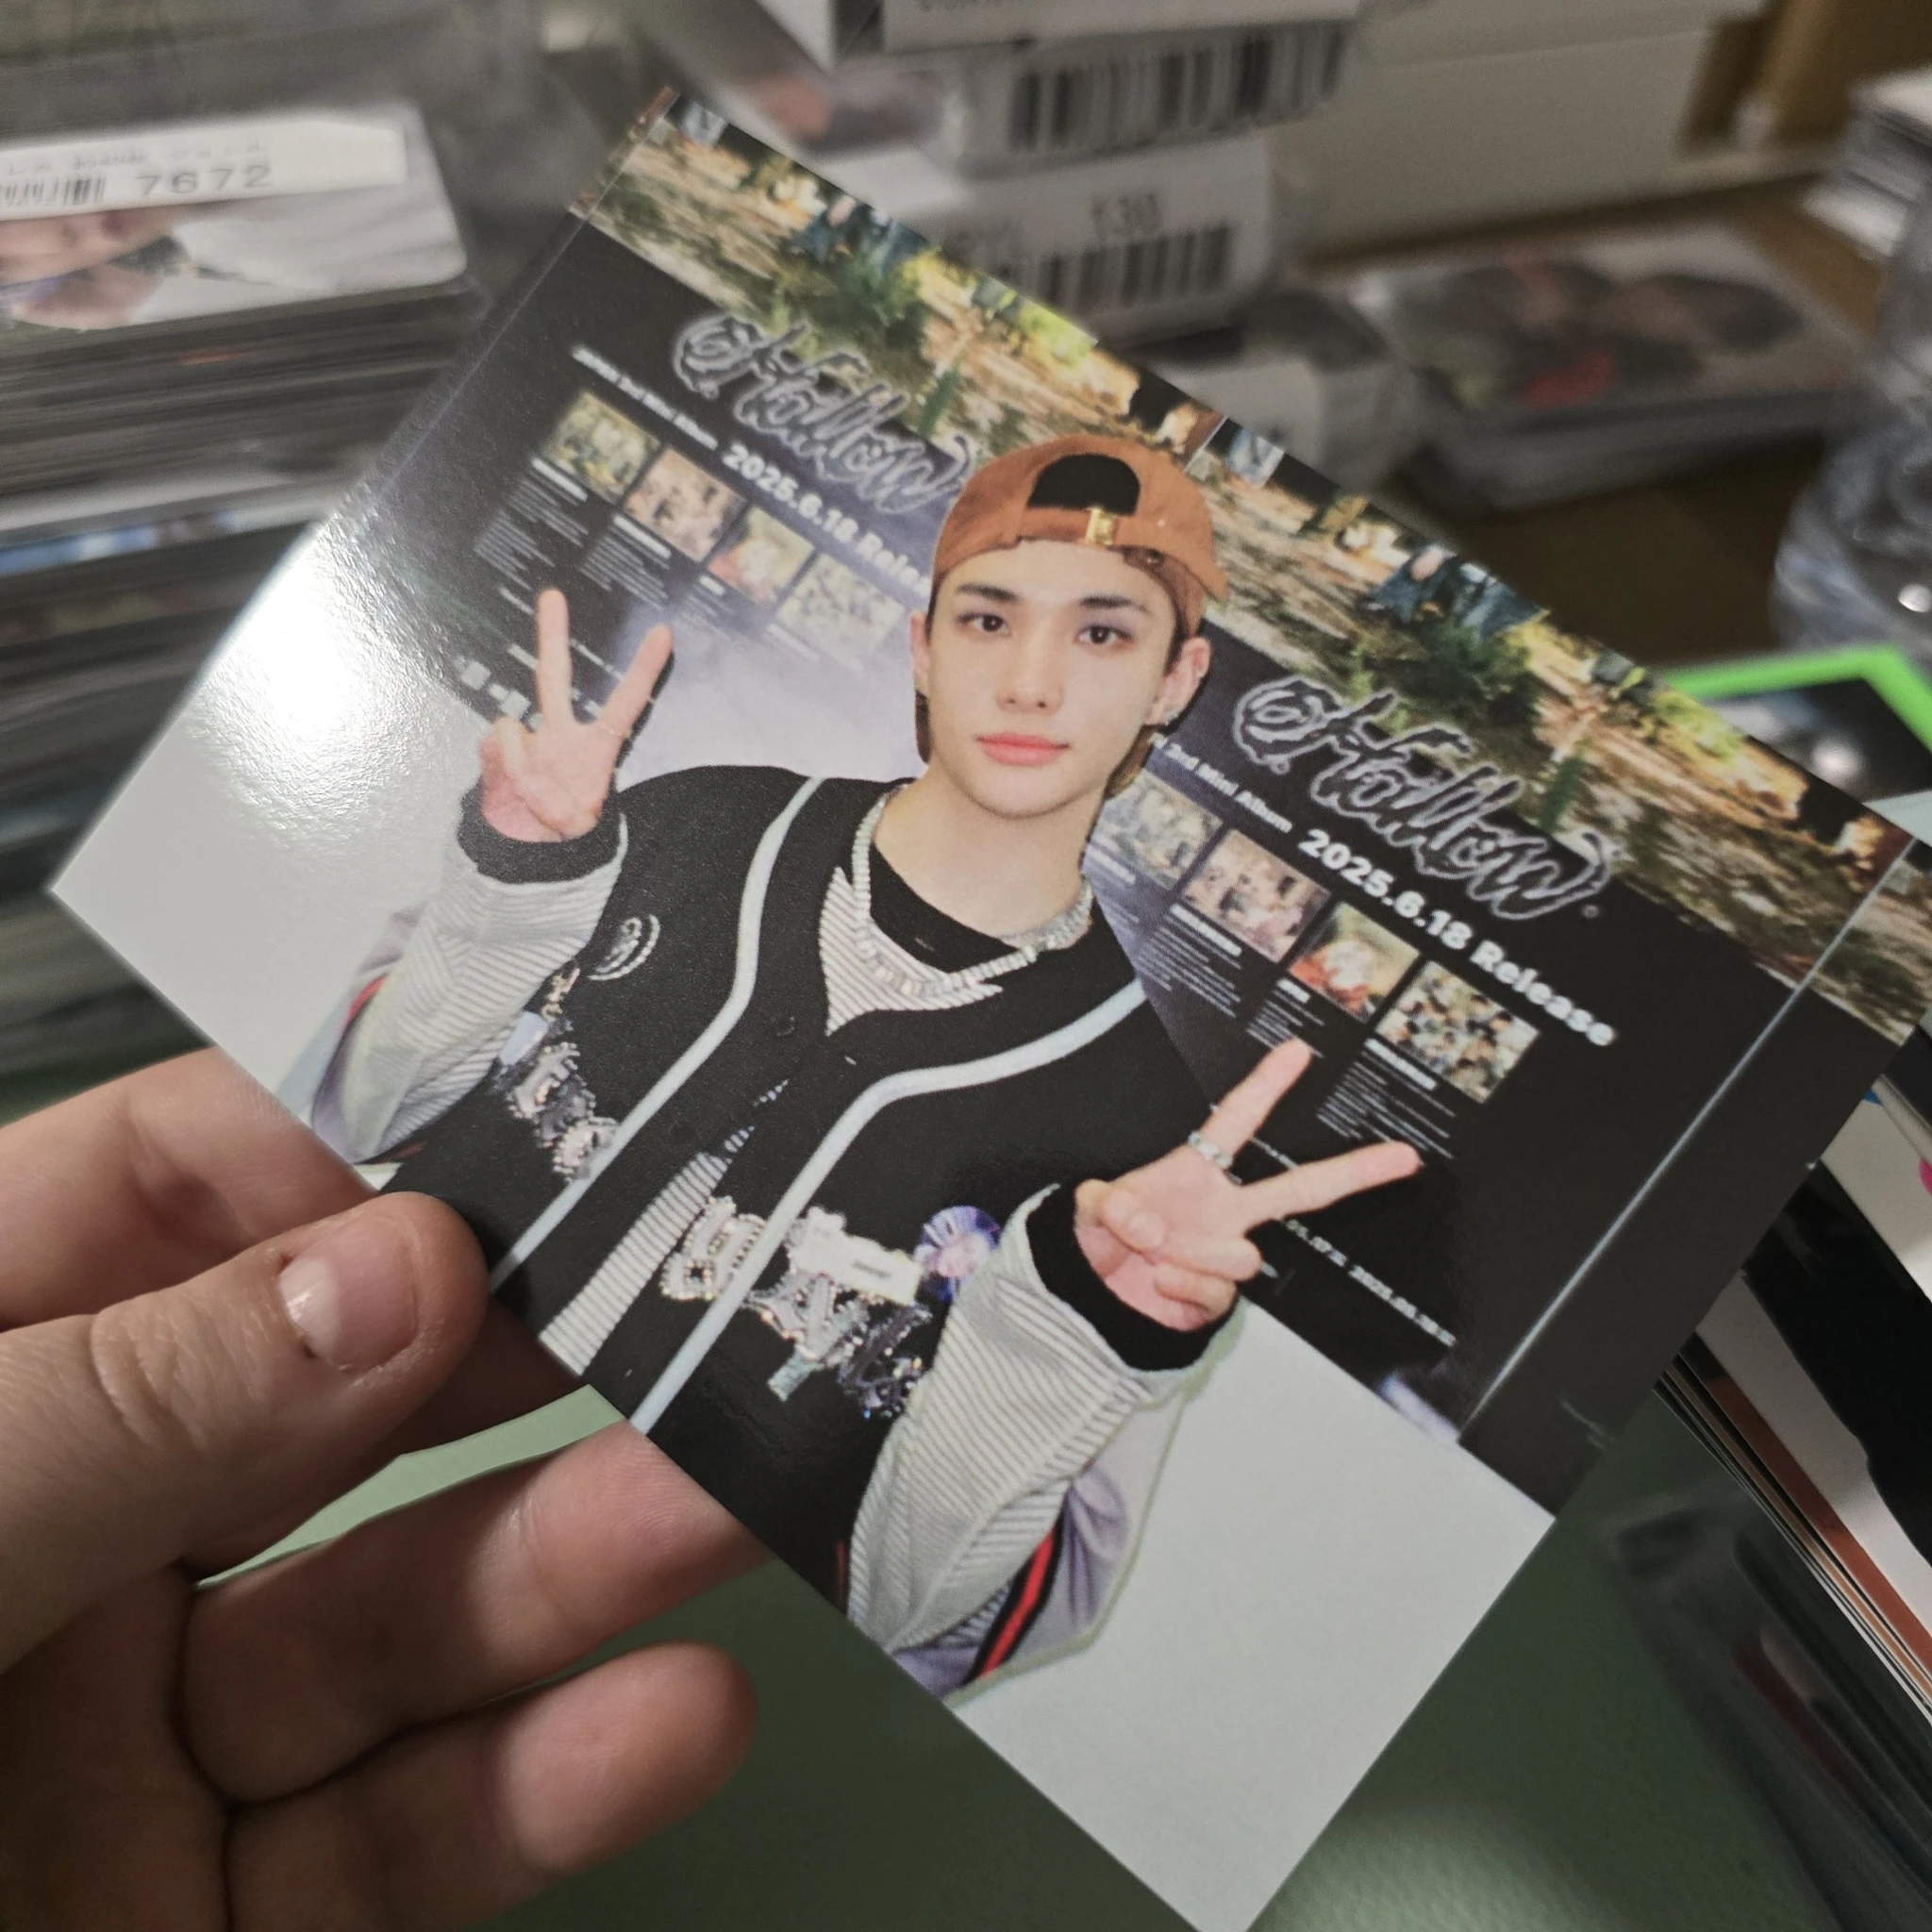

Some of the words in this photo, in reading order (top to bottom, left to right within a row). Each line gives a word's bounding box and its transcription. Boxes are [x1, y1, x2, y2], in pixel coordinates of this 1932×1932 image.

[136, 163, 274, 197] 7672
[1193, 762, 1240, 796] Mini
[1234, 790, 1294, 834] Album
[1298, 829, 1474, 950] 2025.6.18
[1470, 940, 1616, 1047] Release
